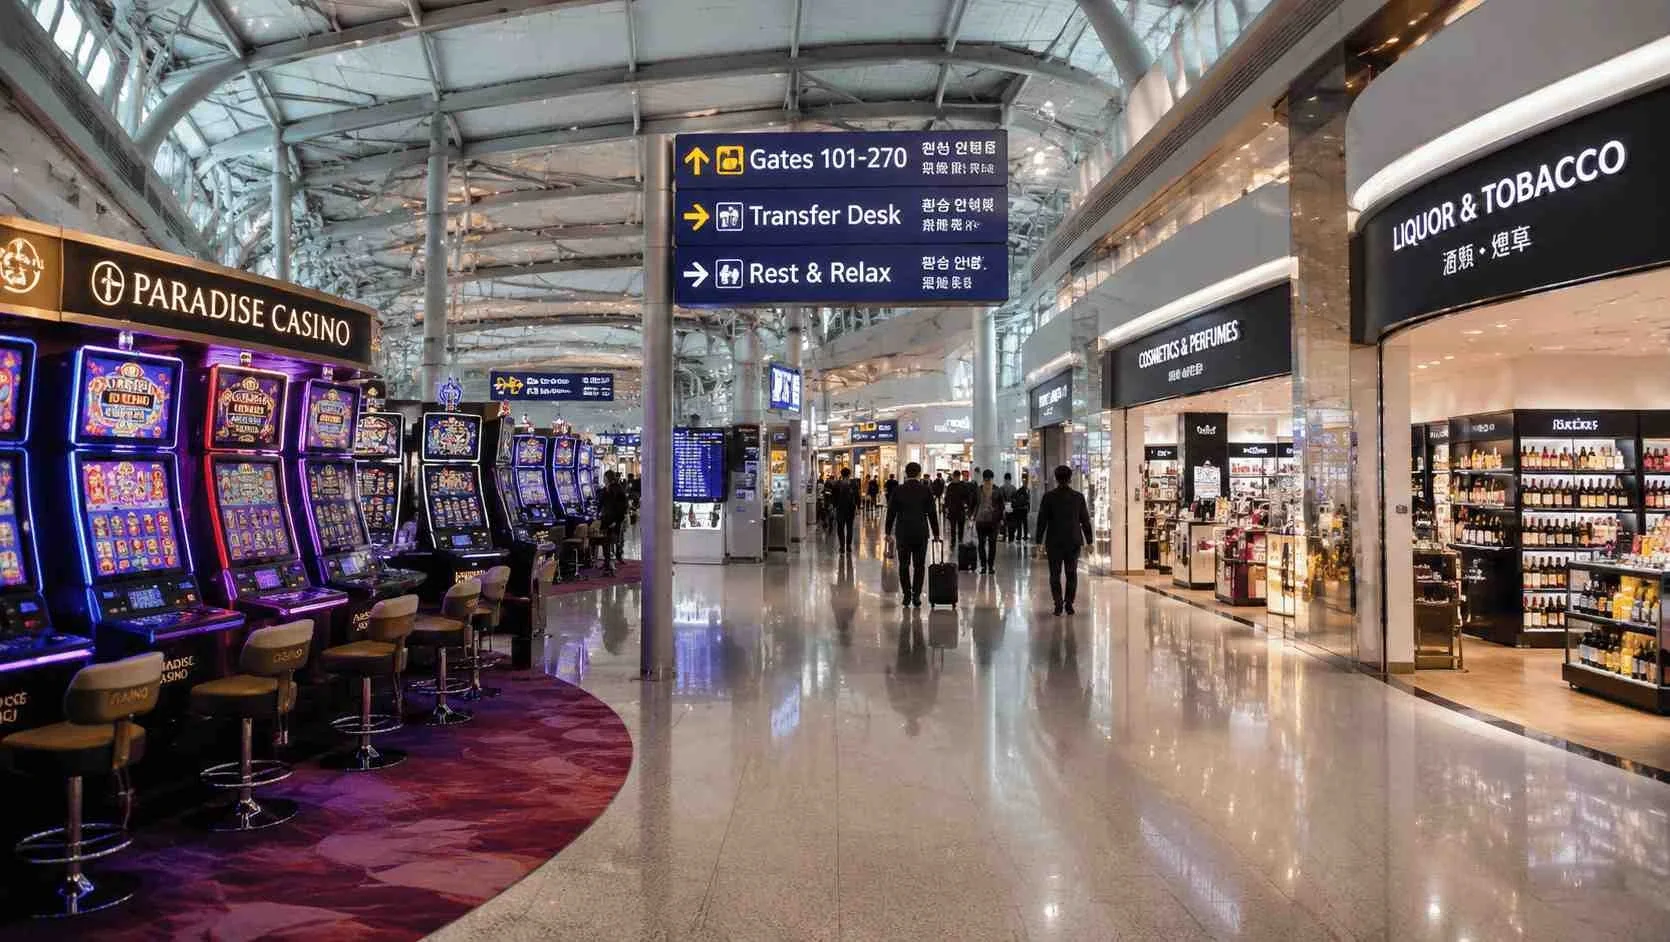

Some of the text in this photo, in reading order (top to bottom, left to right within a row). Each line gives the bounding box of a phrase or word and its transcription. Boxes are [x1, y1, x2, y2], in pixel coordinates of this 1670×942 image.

[750, 148, 814, 170] Gates
[820, 147, 908, 169] 101-270
[1392, 140, 1626, 252] LIQUOR & TOBACCO
[749, 204, 841, 227] Transfer
[847, 203, 902, 226] Desk
[749, 262, 892, 284] Rest & Relax
[132, 272, 351, 346] PARADISE CASINO
[1138, 319, 1239, 369] COSMETICS & PERFUMES
